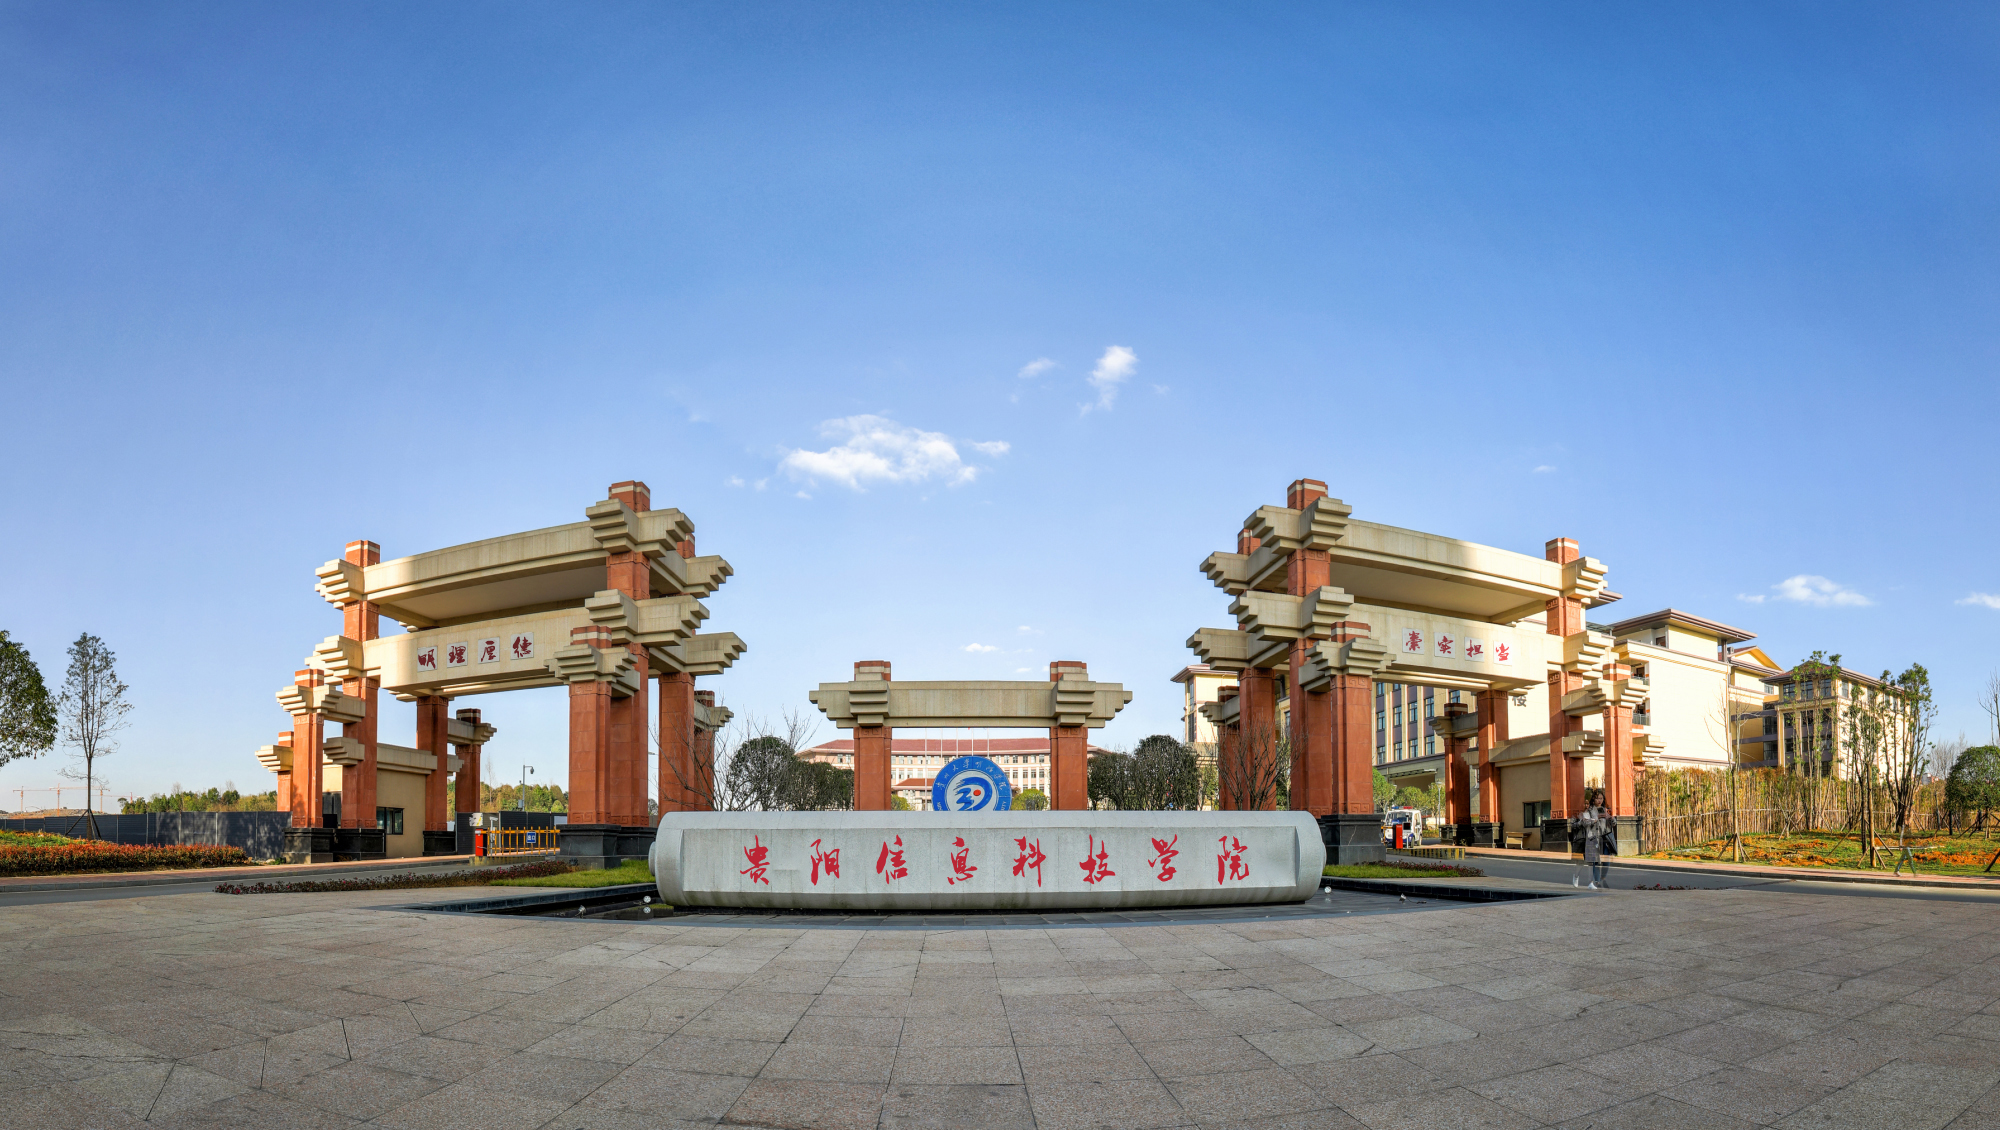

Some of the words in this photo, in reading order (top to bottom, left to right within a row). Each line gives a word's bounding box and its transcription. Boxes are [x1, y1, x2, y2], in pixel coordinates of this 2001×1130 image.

[739, 834, 1250, 888] 贵阳信息科技学院
